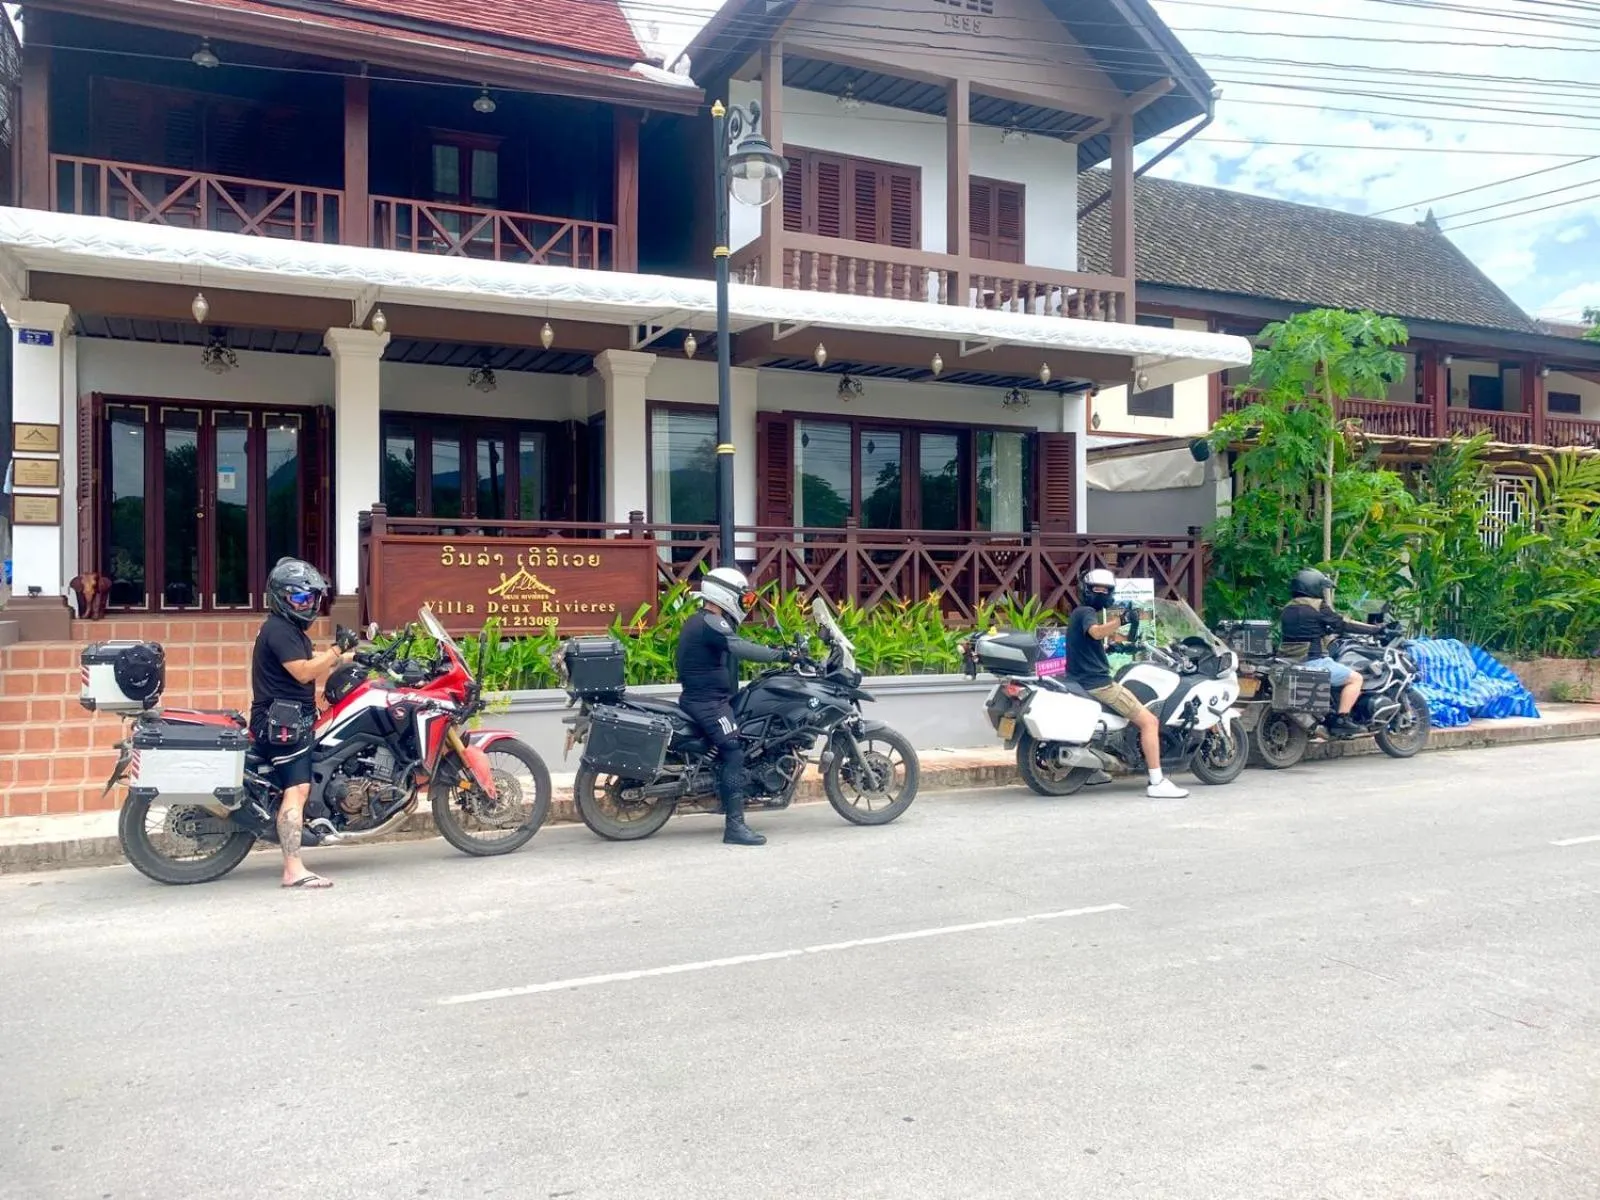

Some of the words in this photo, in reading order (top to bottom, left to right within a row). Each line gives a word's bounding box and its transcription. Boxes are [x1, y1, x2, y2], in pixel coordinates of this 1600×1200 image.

[424, 601, 474, 613] Villa
[488, 601, 530, 613] Deux
[542, 600, 616, 613] Rivieres
